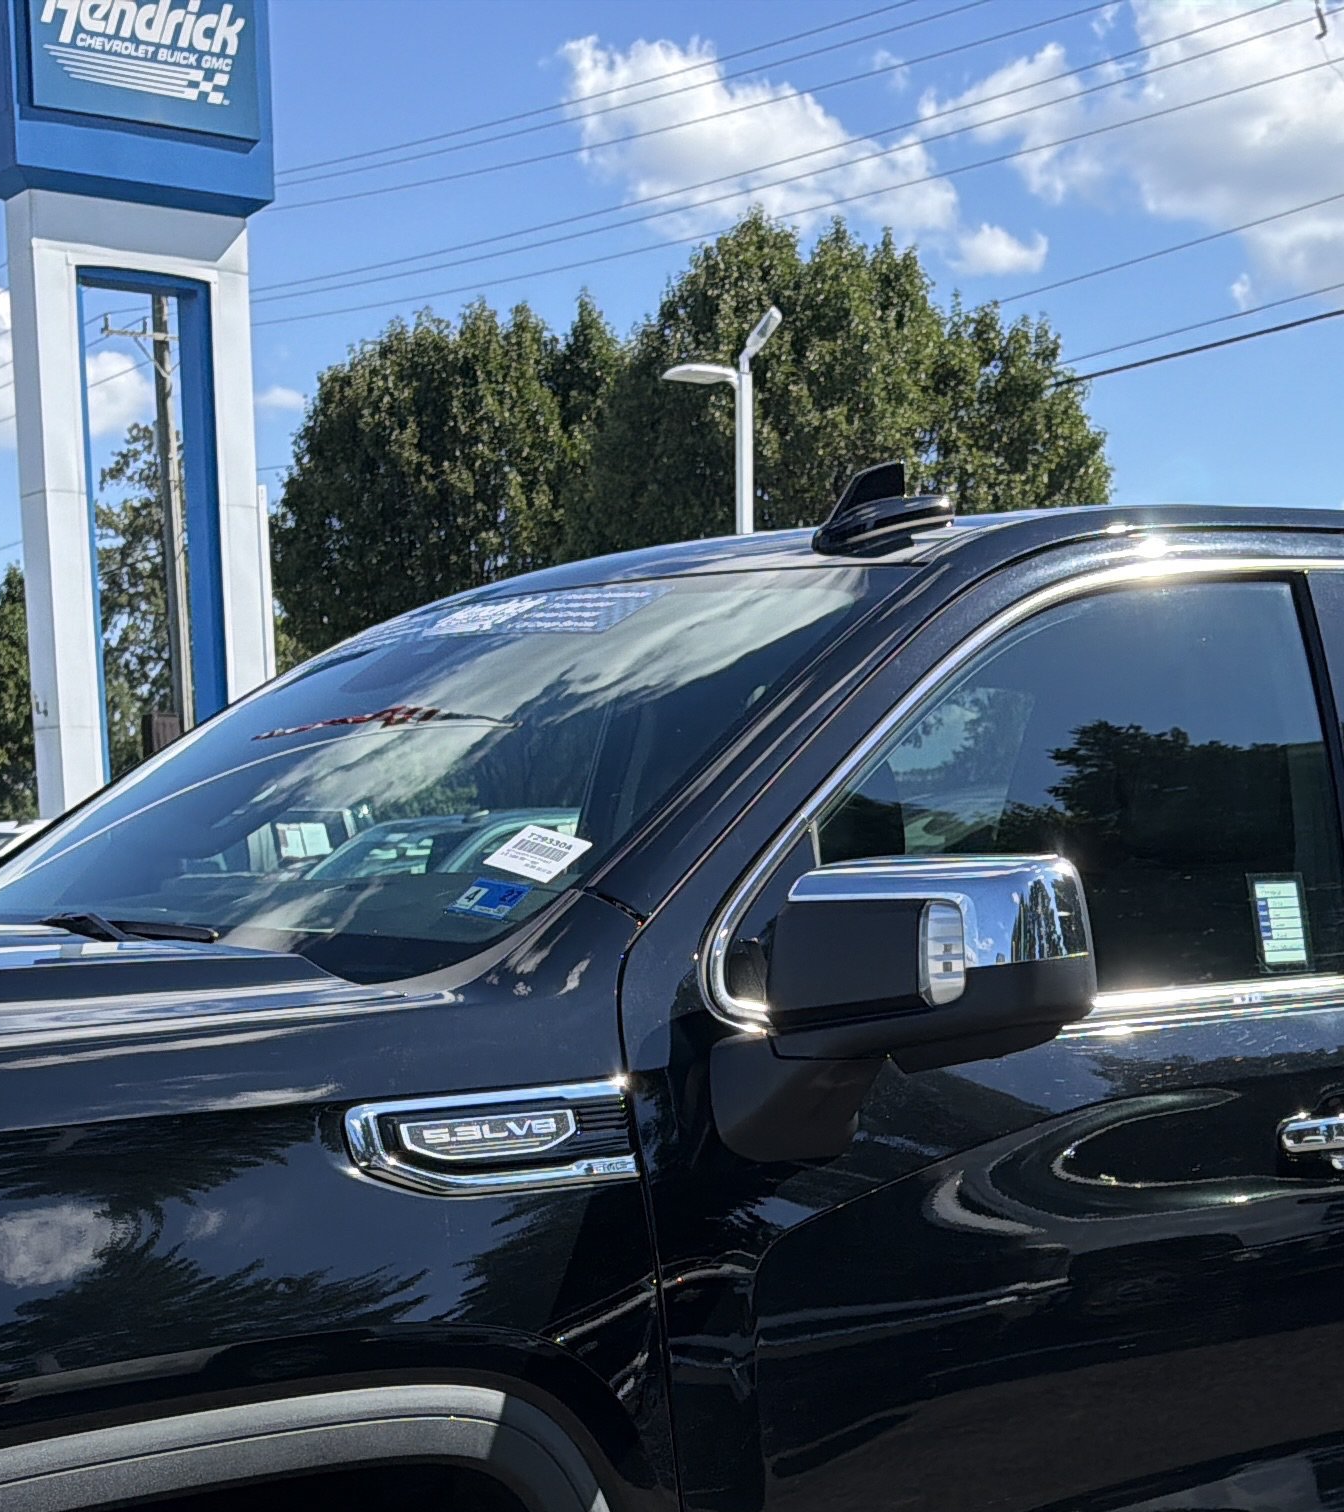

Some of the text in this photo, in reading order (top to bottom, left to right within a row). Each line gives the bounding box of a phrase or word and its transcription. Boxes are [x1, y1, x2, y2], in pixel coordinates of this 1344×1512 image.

[41, 0, 245, 55] Hendrick
[76, 33, 232, 71] CHEVROLET BUICK GMC
